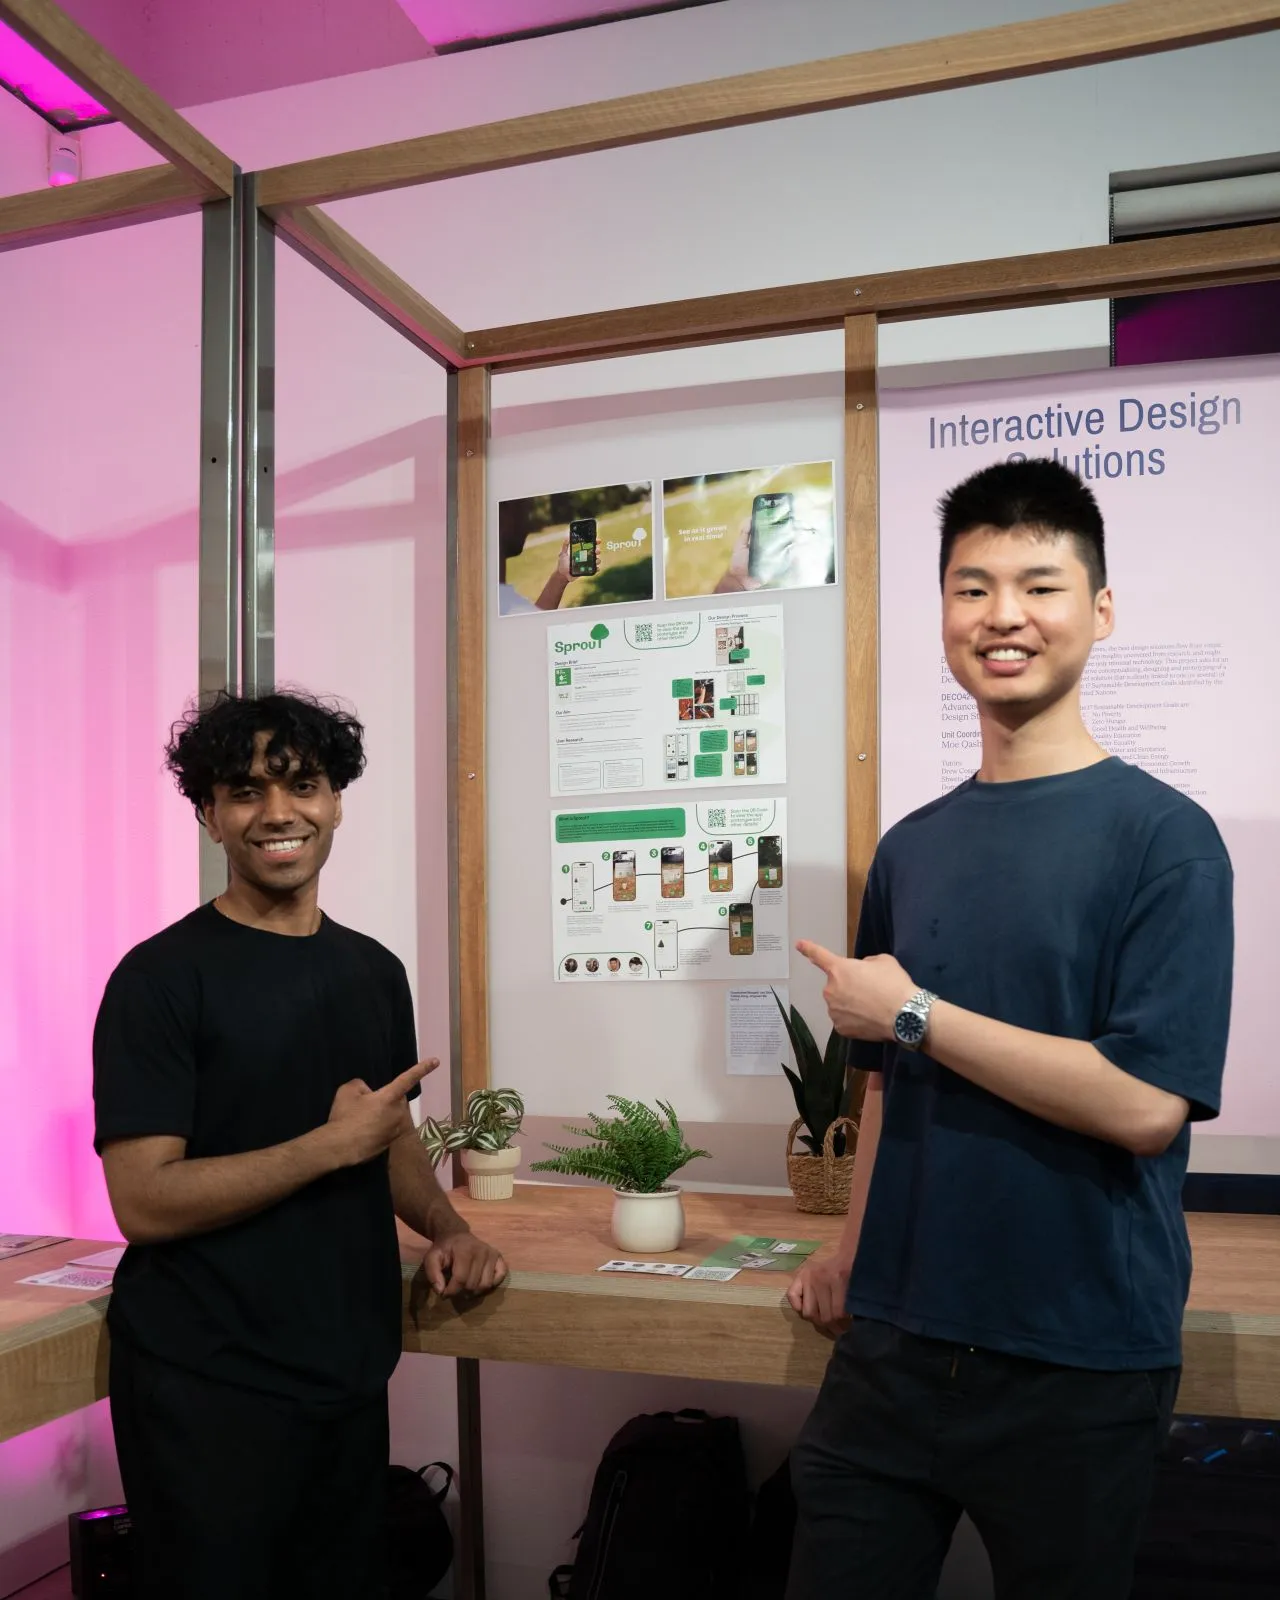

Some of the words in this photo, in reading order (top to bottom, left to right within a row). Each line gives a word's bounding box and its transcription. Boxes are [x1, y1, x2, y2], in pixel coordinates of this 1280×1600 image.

[929, 403, 1105, 449] Interactive
[1119, 391, 1242, 436] Design
[606, 538, 643, 552] Sprout
[554, 639, 602, 655] Sprout
[942, 693, 976, 701] DECO42
[942, 702, 978, 711] Advance
[942, 712, 968, 722] Design
[942, 740, 959, 748] Moe
